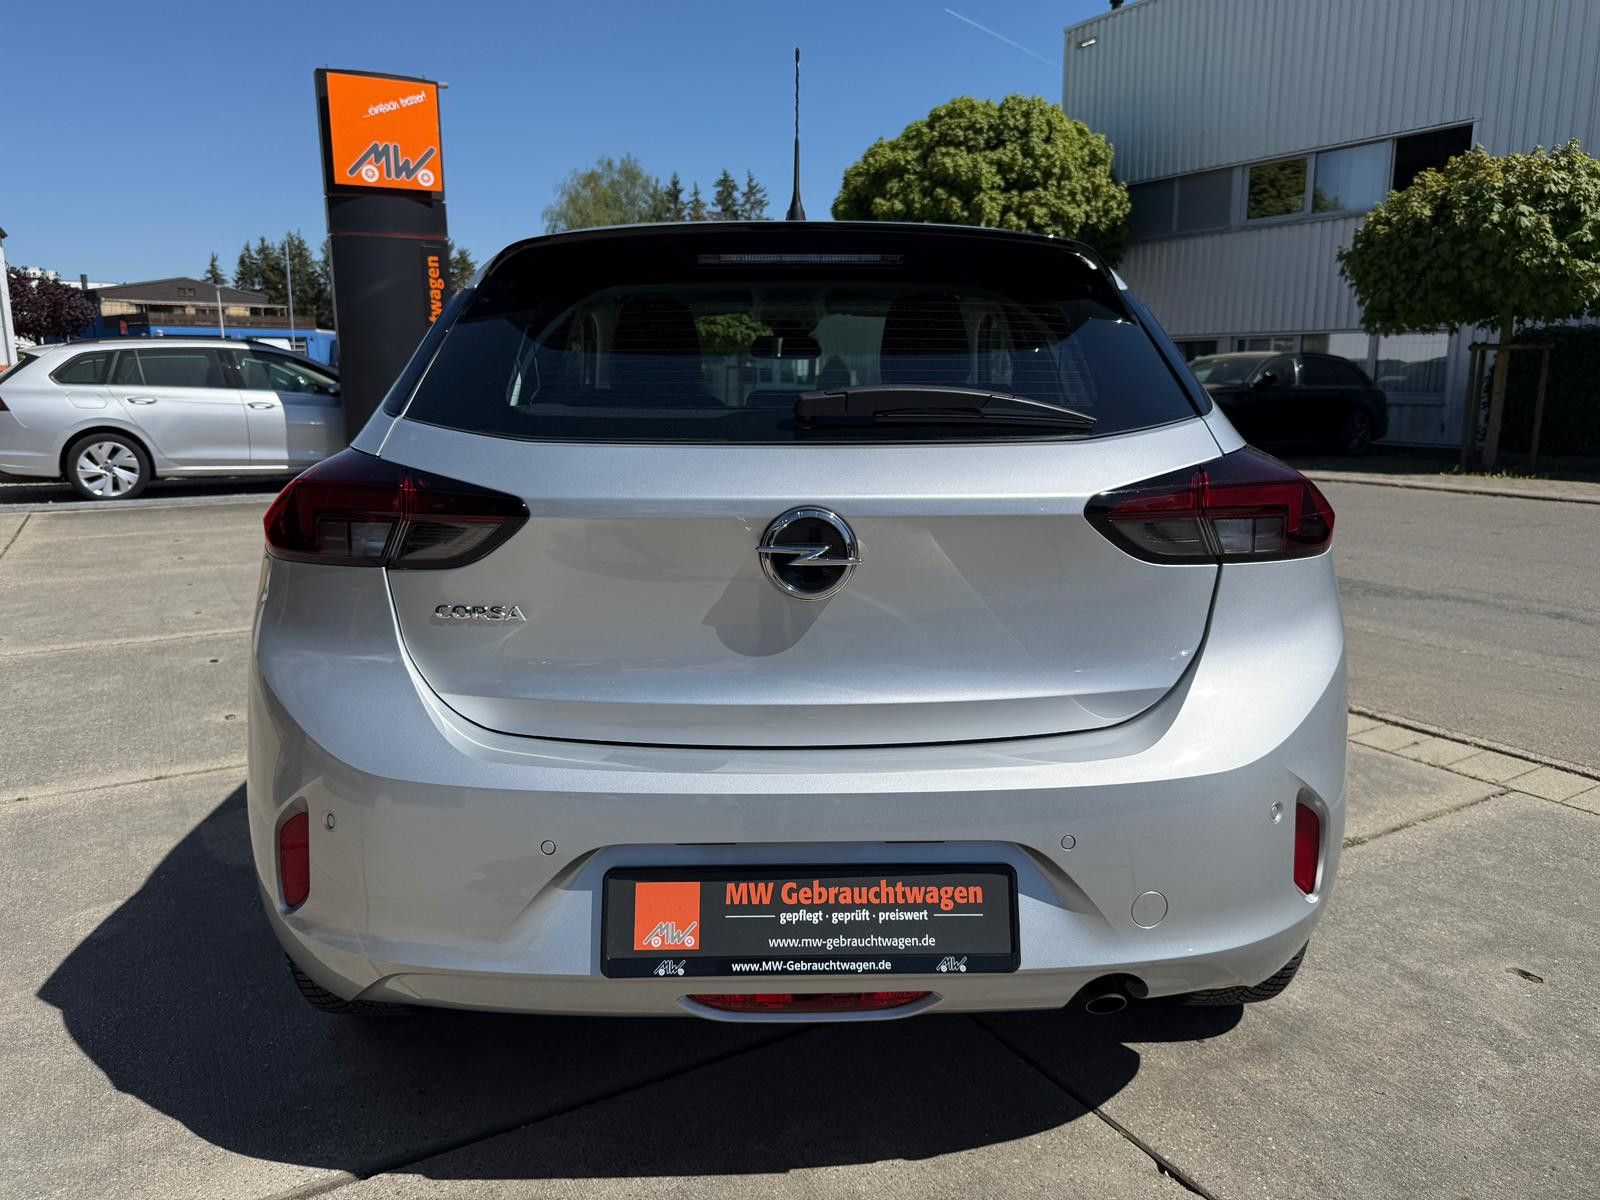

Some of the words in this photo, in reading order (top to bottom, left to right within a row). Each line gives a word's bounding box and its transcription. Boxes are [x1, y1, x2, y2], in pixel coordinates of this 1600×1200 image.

[347, 141, 436, 187] MW
[435, 604, 526, 621] CORSA
[725, 882, 774, 905] MW
[781, 879, 983, 911] Gebrauchtwagen
[779, 909, 823, 924] gepflegt
[831, 909, 870, 924] geprüft
[878, 909, 928, 924] preiswert
[643, 921, 697, 948] MW
[768, 934, 936, 950] www.mw-gebrauchtwagen.de
[732, 960, 892, 973] www.MW-Gebrauchtwagen.de
